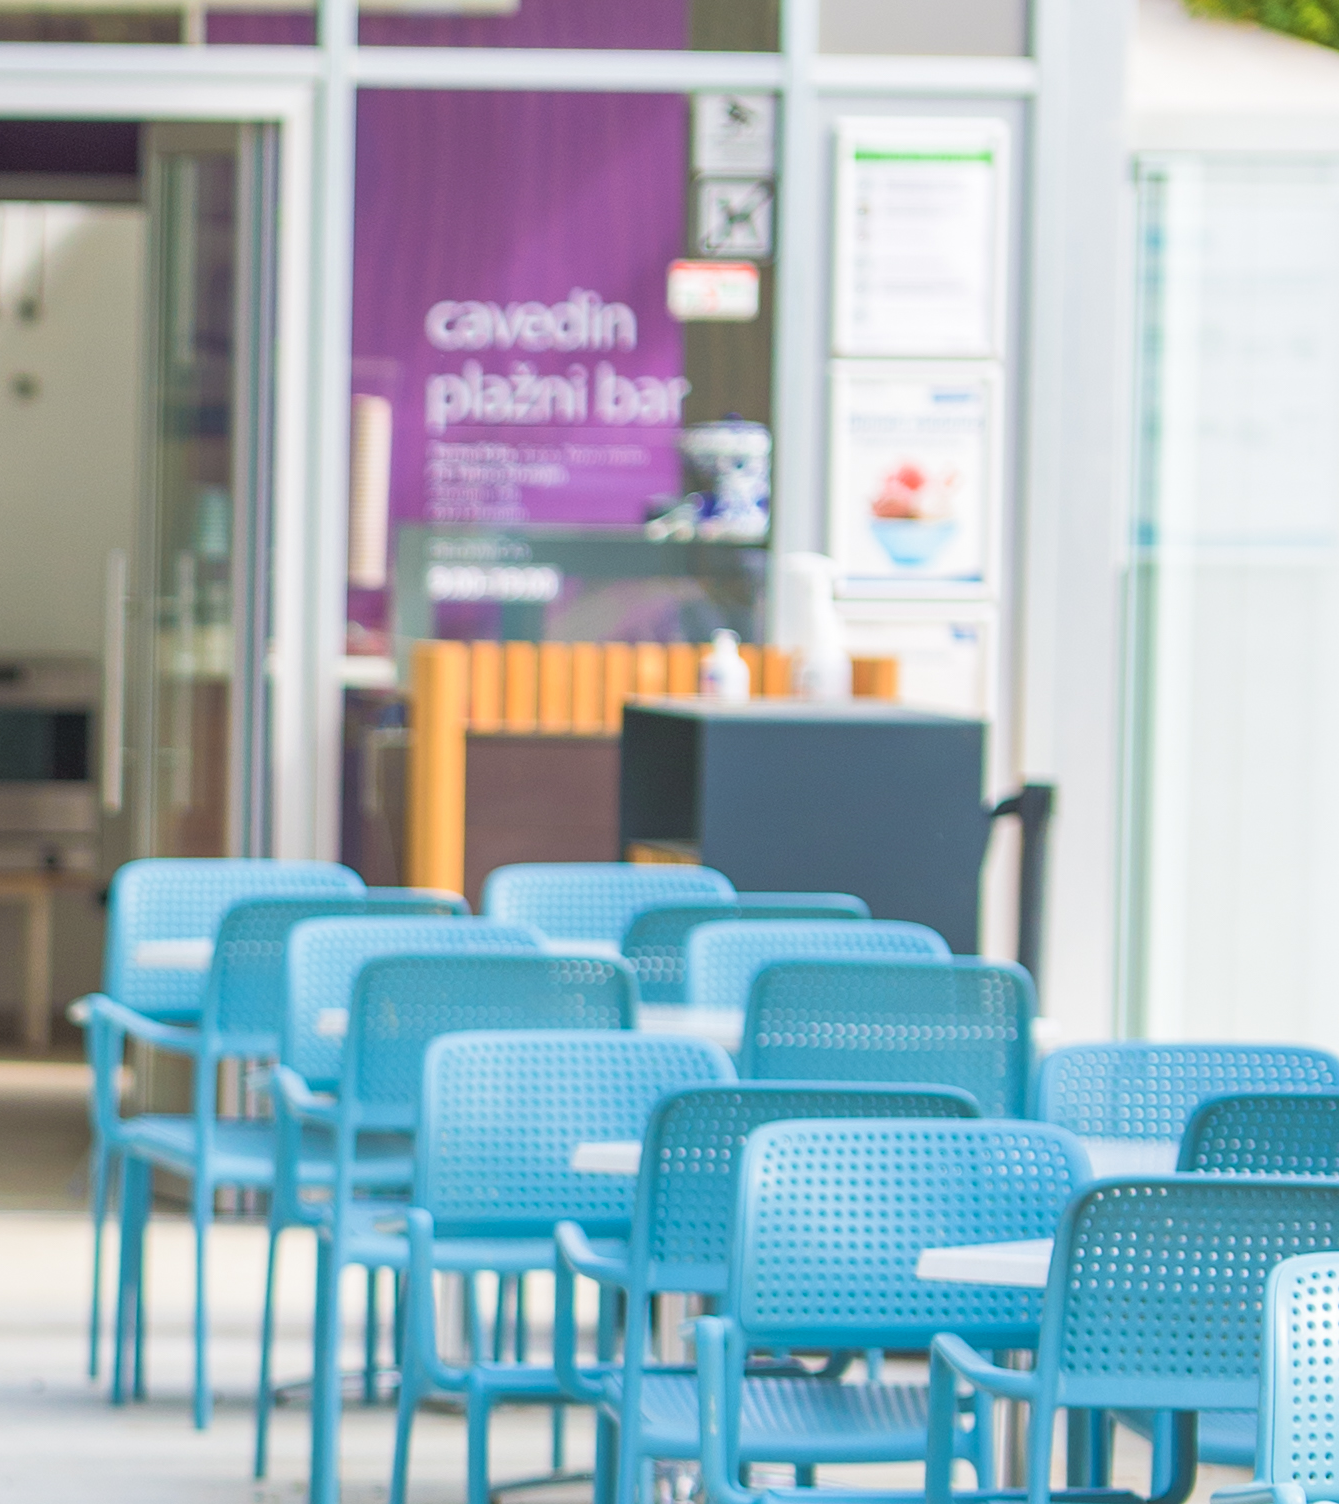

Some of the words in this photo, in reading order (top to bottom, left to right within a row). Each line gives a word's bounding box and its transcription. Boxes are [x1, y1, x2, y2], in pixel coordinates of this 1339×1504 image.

[425, 286, 637, 351] cavedin
[426, 359, 588, 436] plažni
[594, 360, 691, 426] bar
